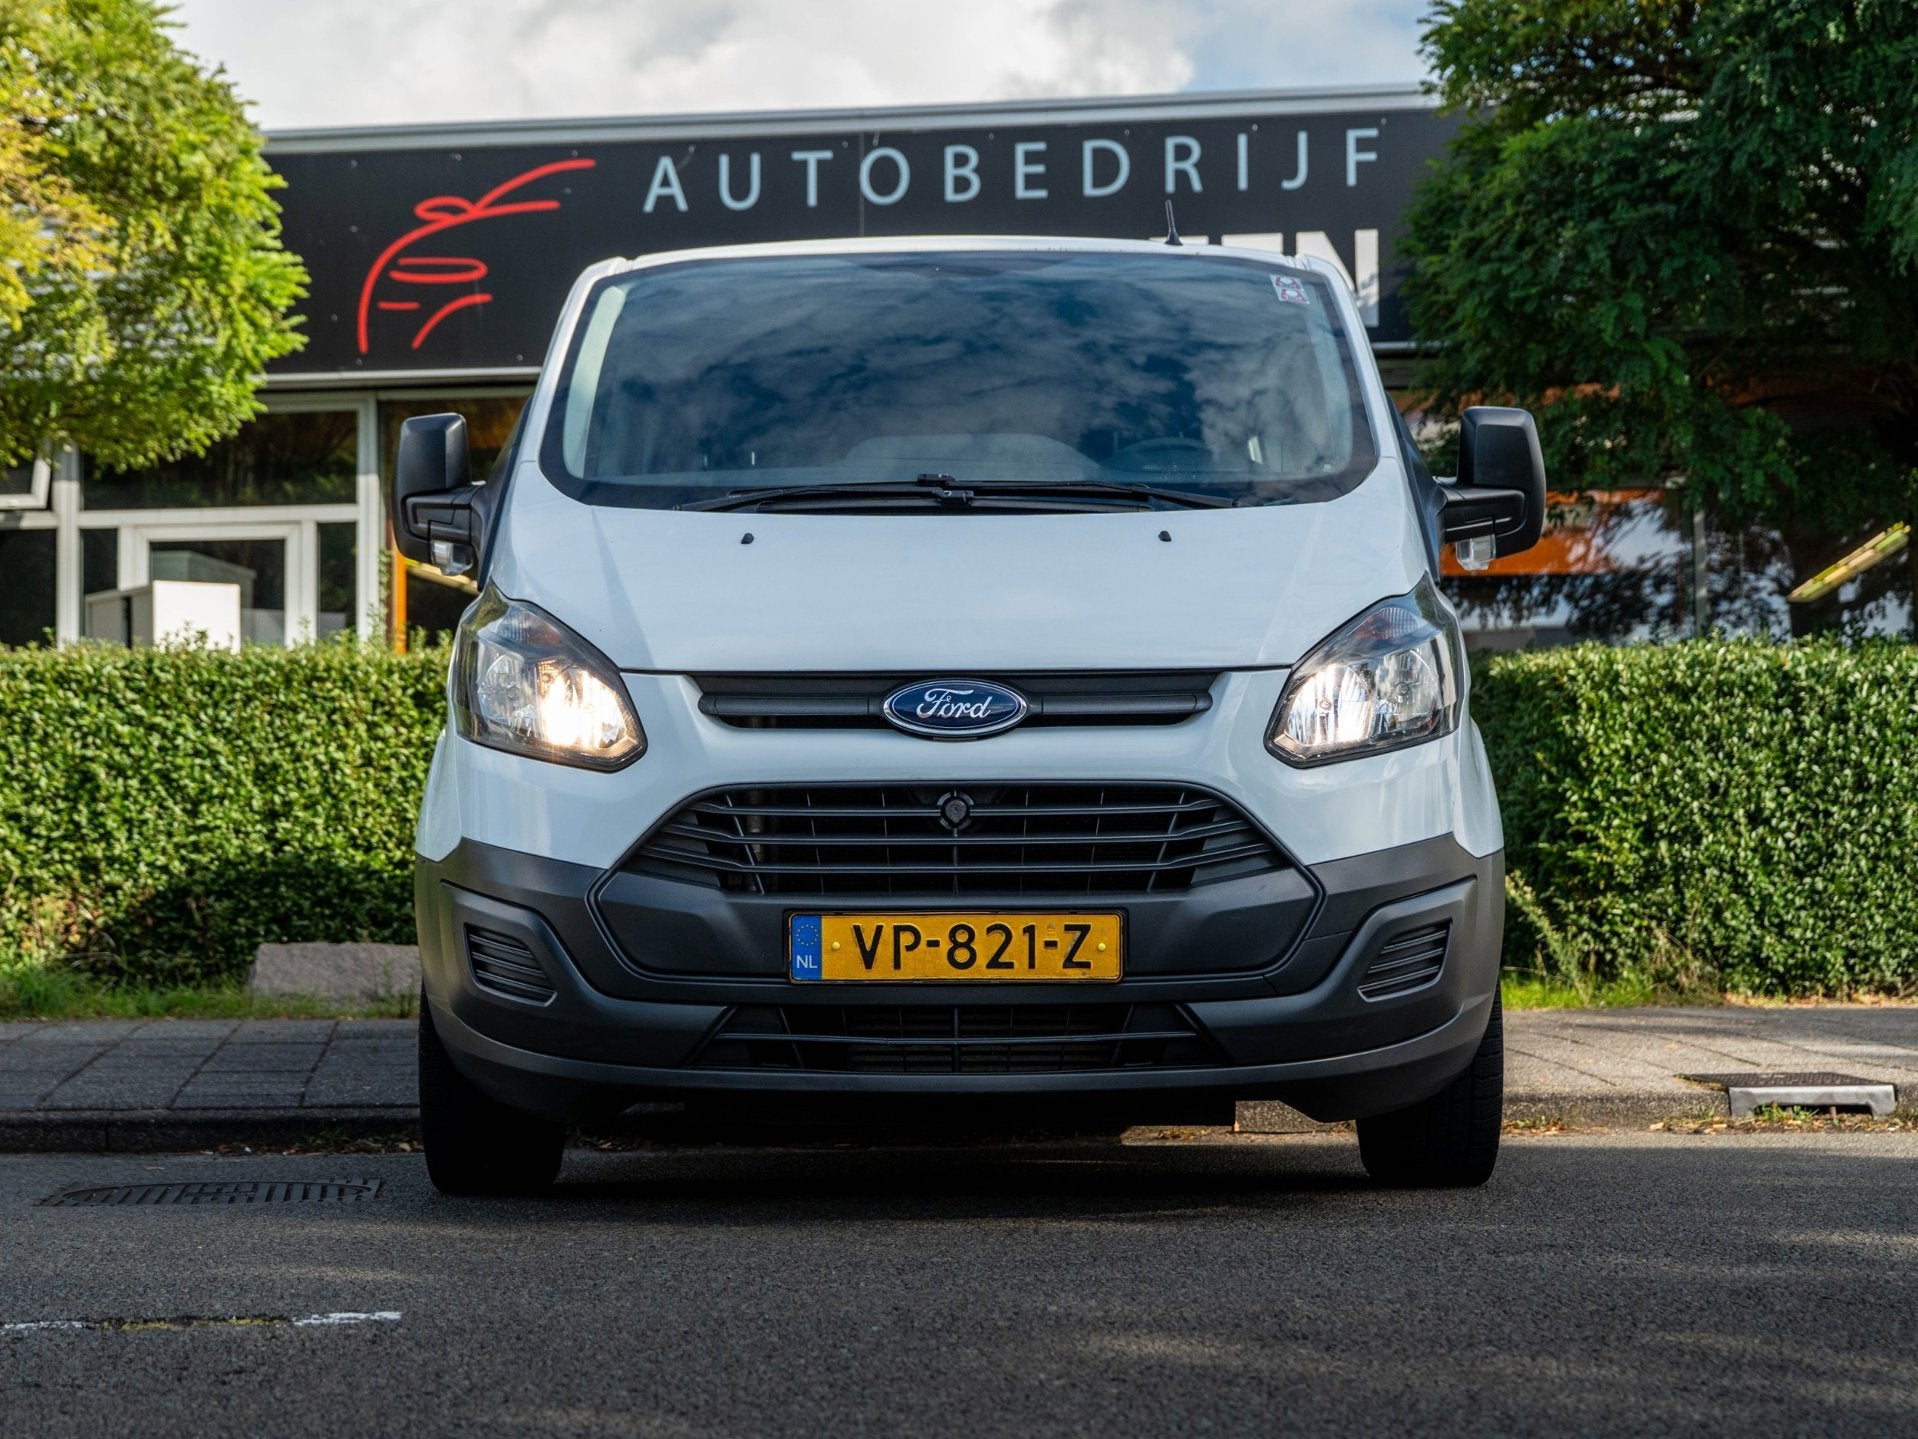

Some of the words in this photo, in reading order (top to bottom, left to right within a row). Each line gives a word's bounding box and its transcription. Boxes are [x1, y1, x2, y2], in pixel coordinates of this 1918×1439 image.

[643, 128, 1380, 213] AUTOBEDRIJF
[915, 688, 993, 719] Ford
[796, 955, 818, 969] NL
[852, 923, 1092, 971] VP-821-Z
